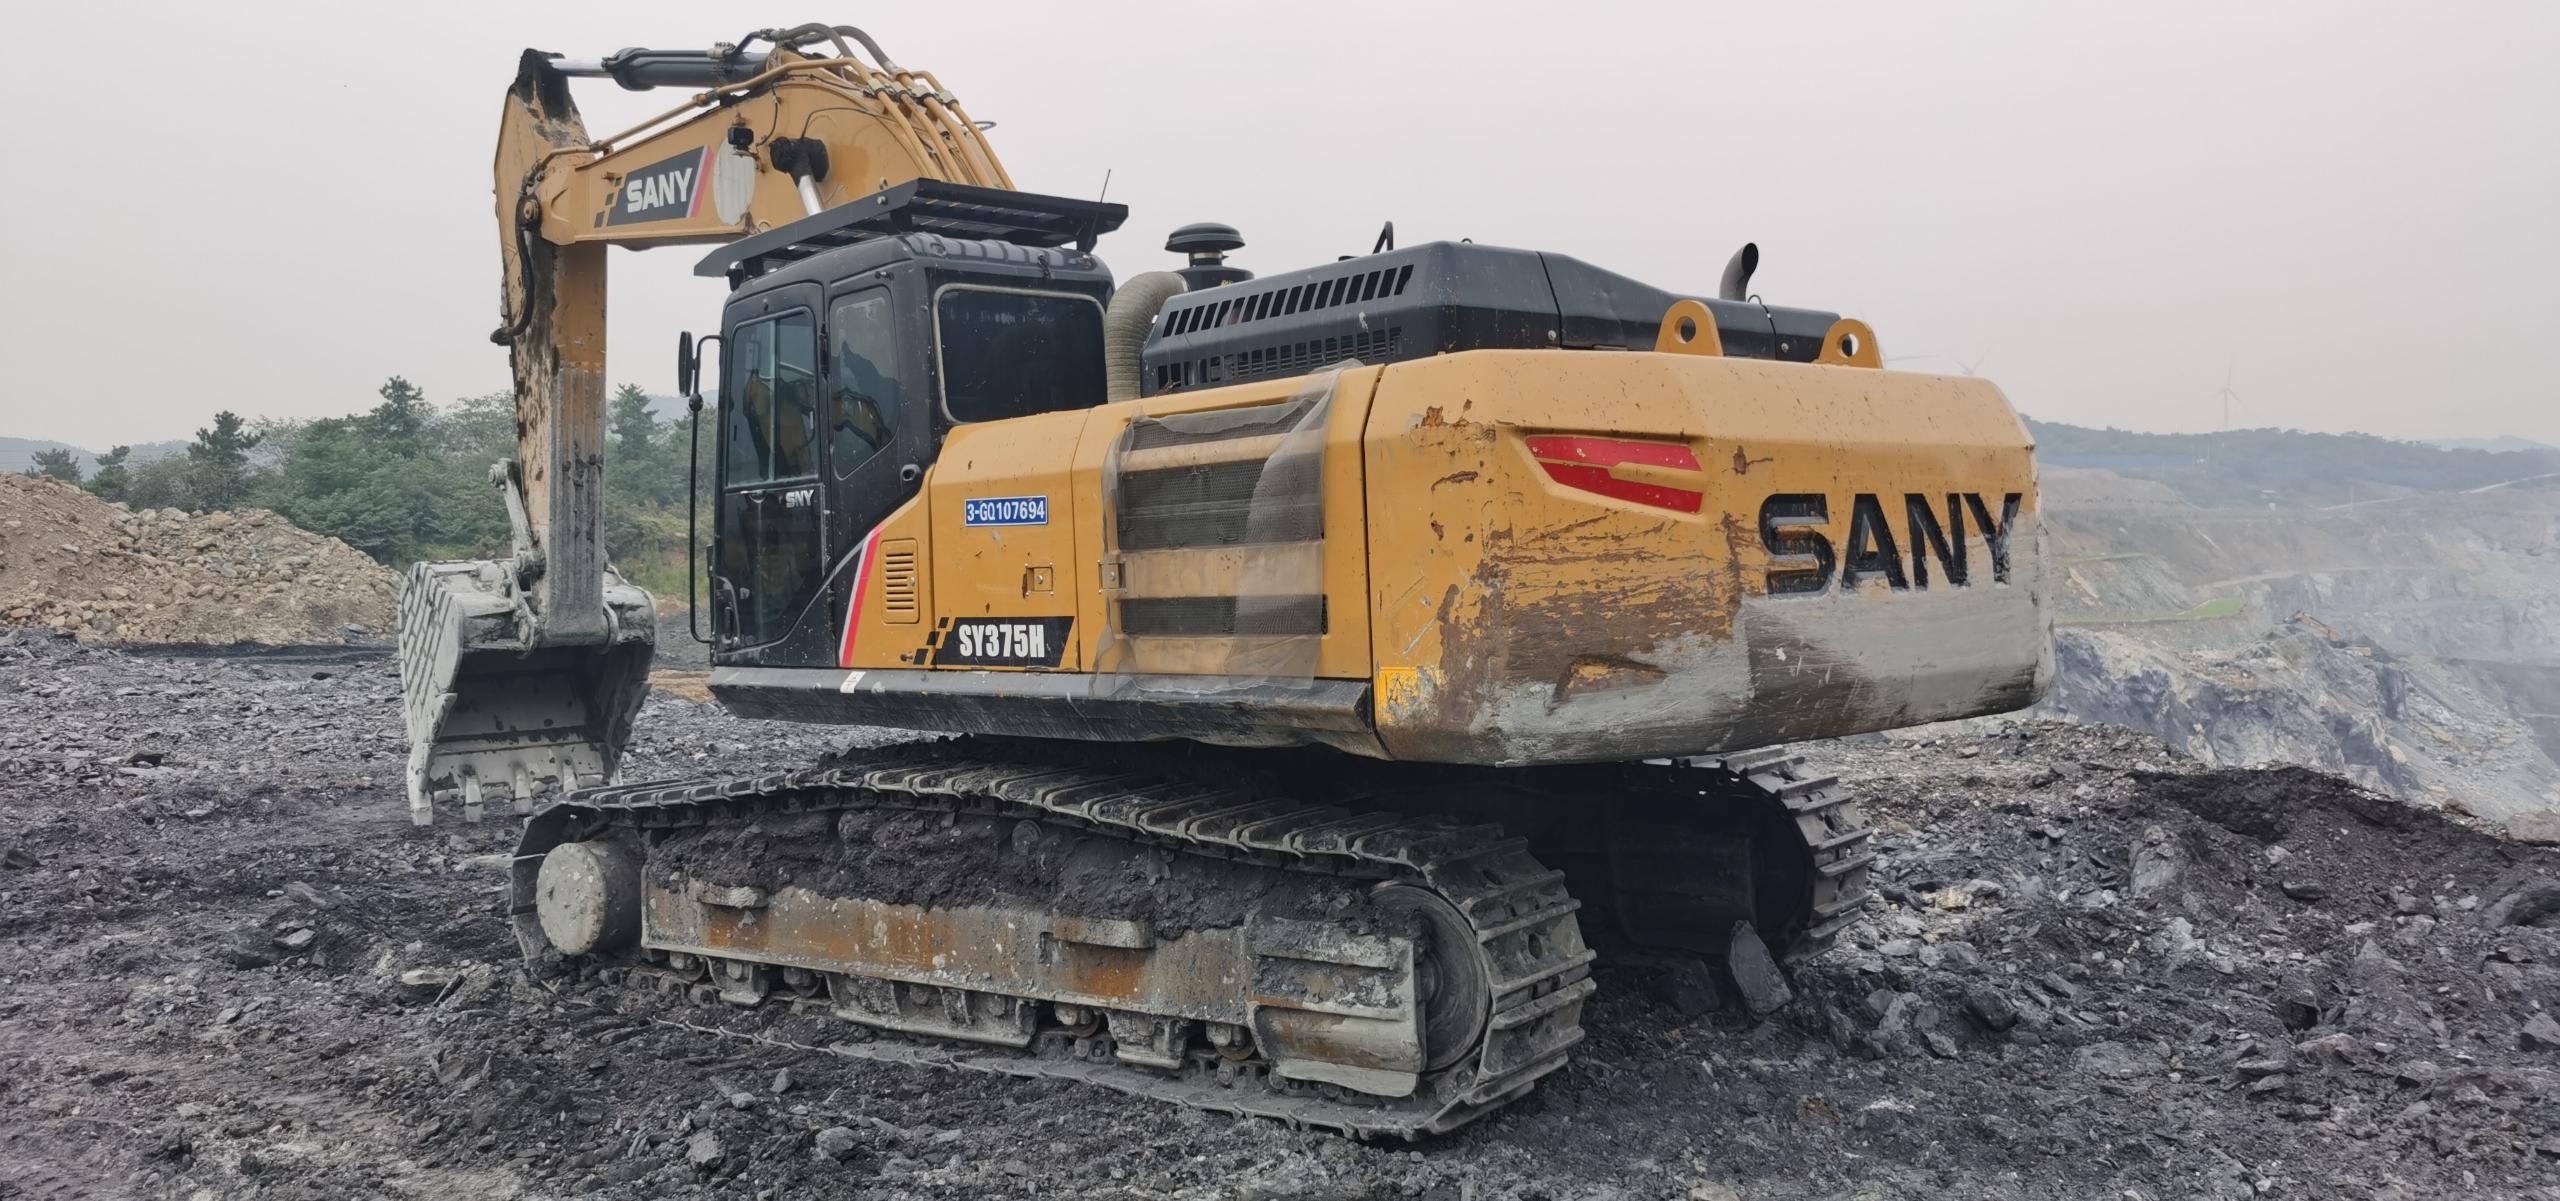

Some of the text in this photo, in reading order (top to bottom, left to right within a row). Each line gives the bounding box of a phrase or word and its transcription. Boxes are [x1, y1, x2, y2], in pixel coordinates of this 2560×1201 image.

[627, 168, 692, 213] SANY
[967, 501, 1045, 521] 3-GQ107694
[1759, 493, 2022, 599] SANY
[959, 624, 1045, 658] SY375H
